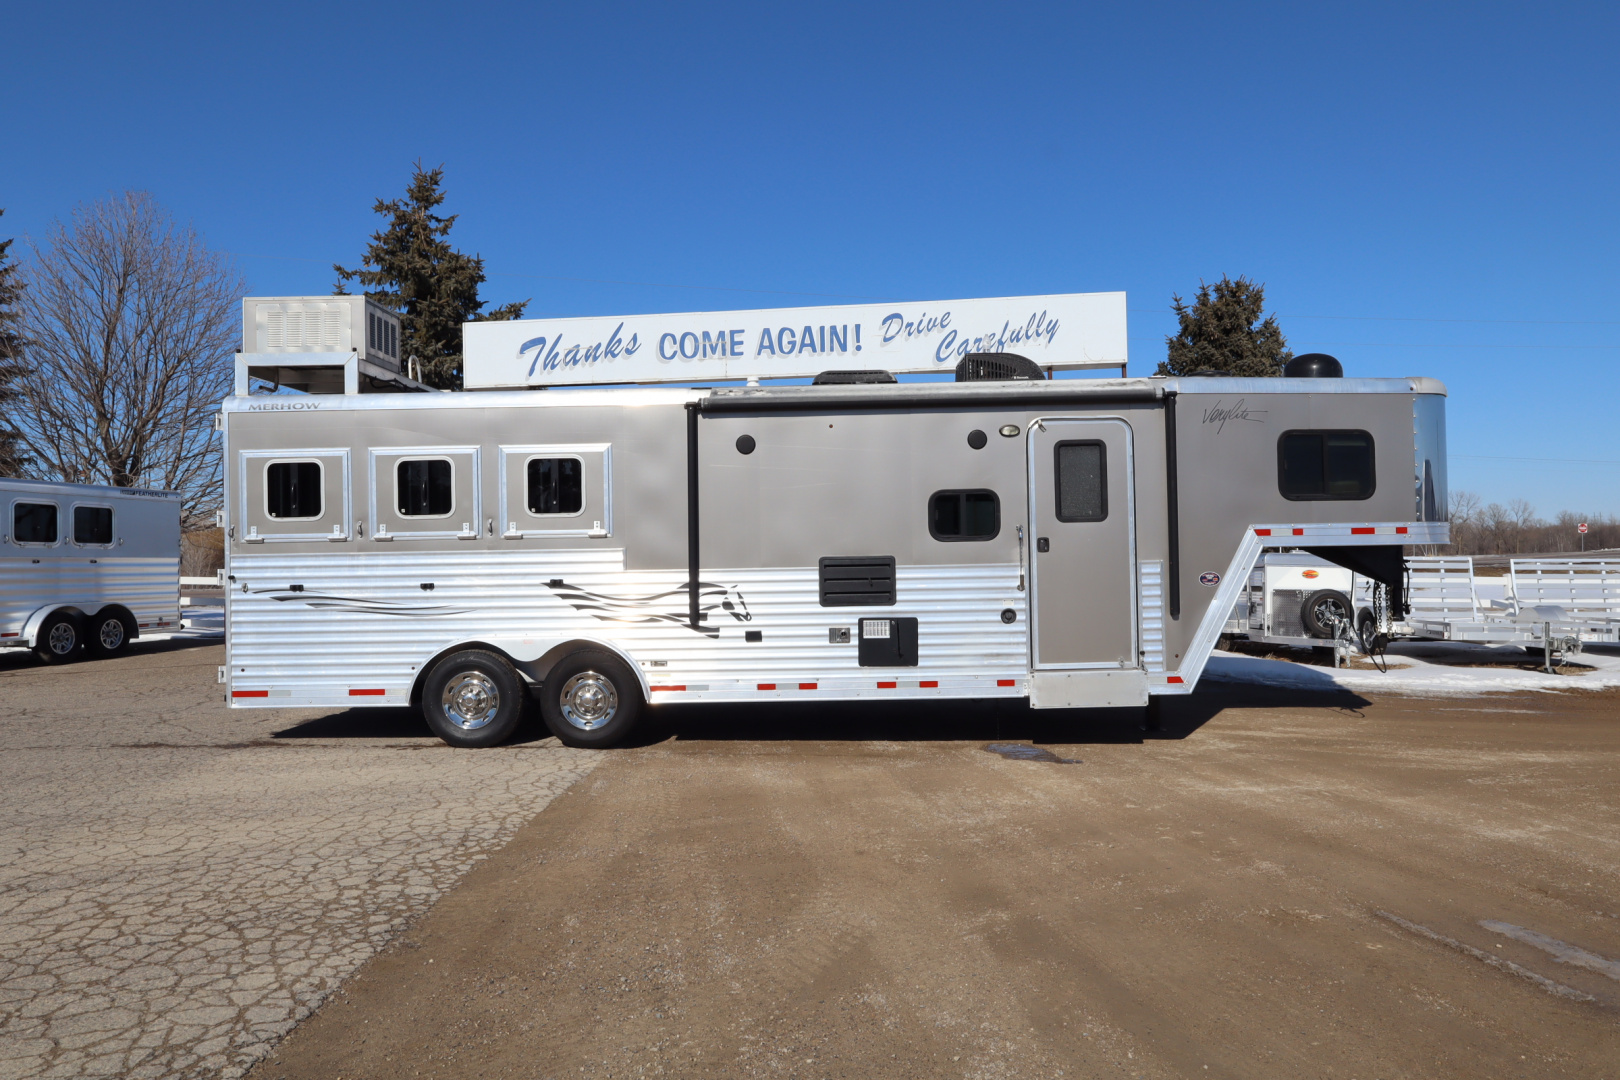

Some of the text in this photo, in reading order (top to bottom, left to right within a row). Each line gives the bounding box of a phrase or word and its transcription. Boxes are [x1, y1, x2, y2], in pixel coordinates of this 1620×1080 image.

[882, 312, 951, 343] Drive
[519, 322, 862, 377] Thanks COME AGAIN!
[248, 402, 321, 411] MERHOW
